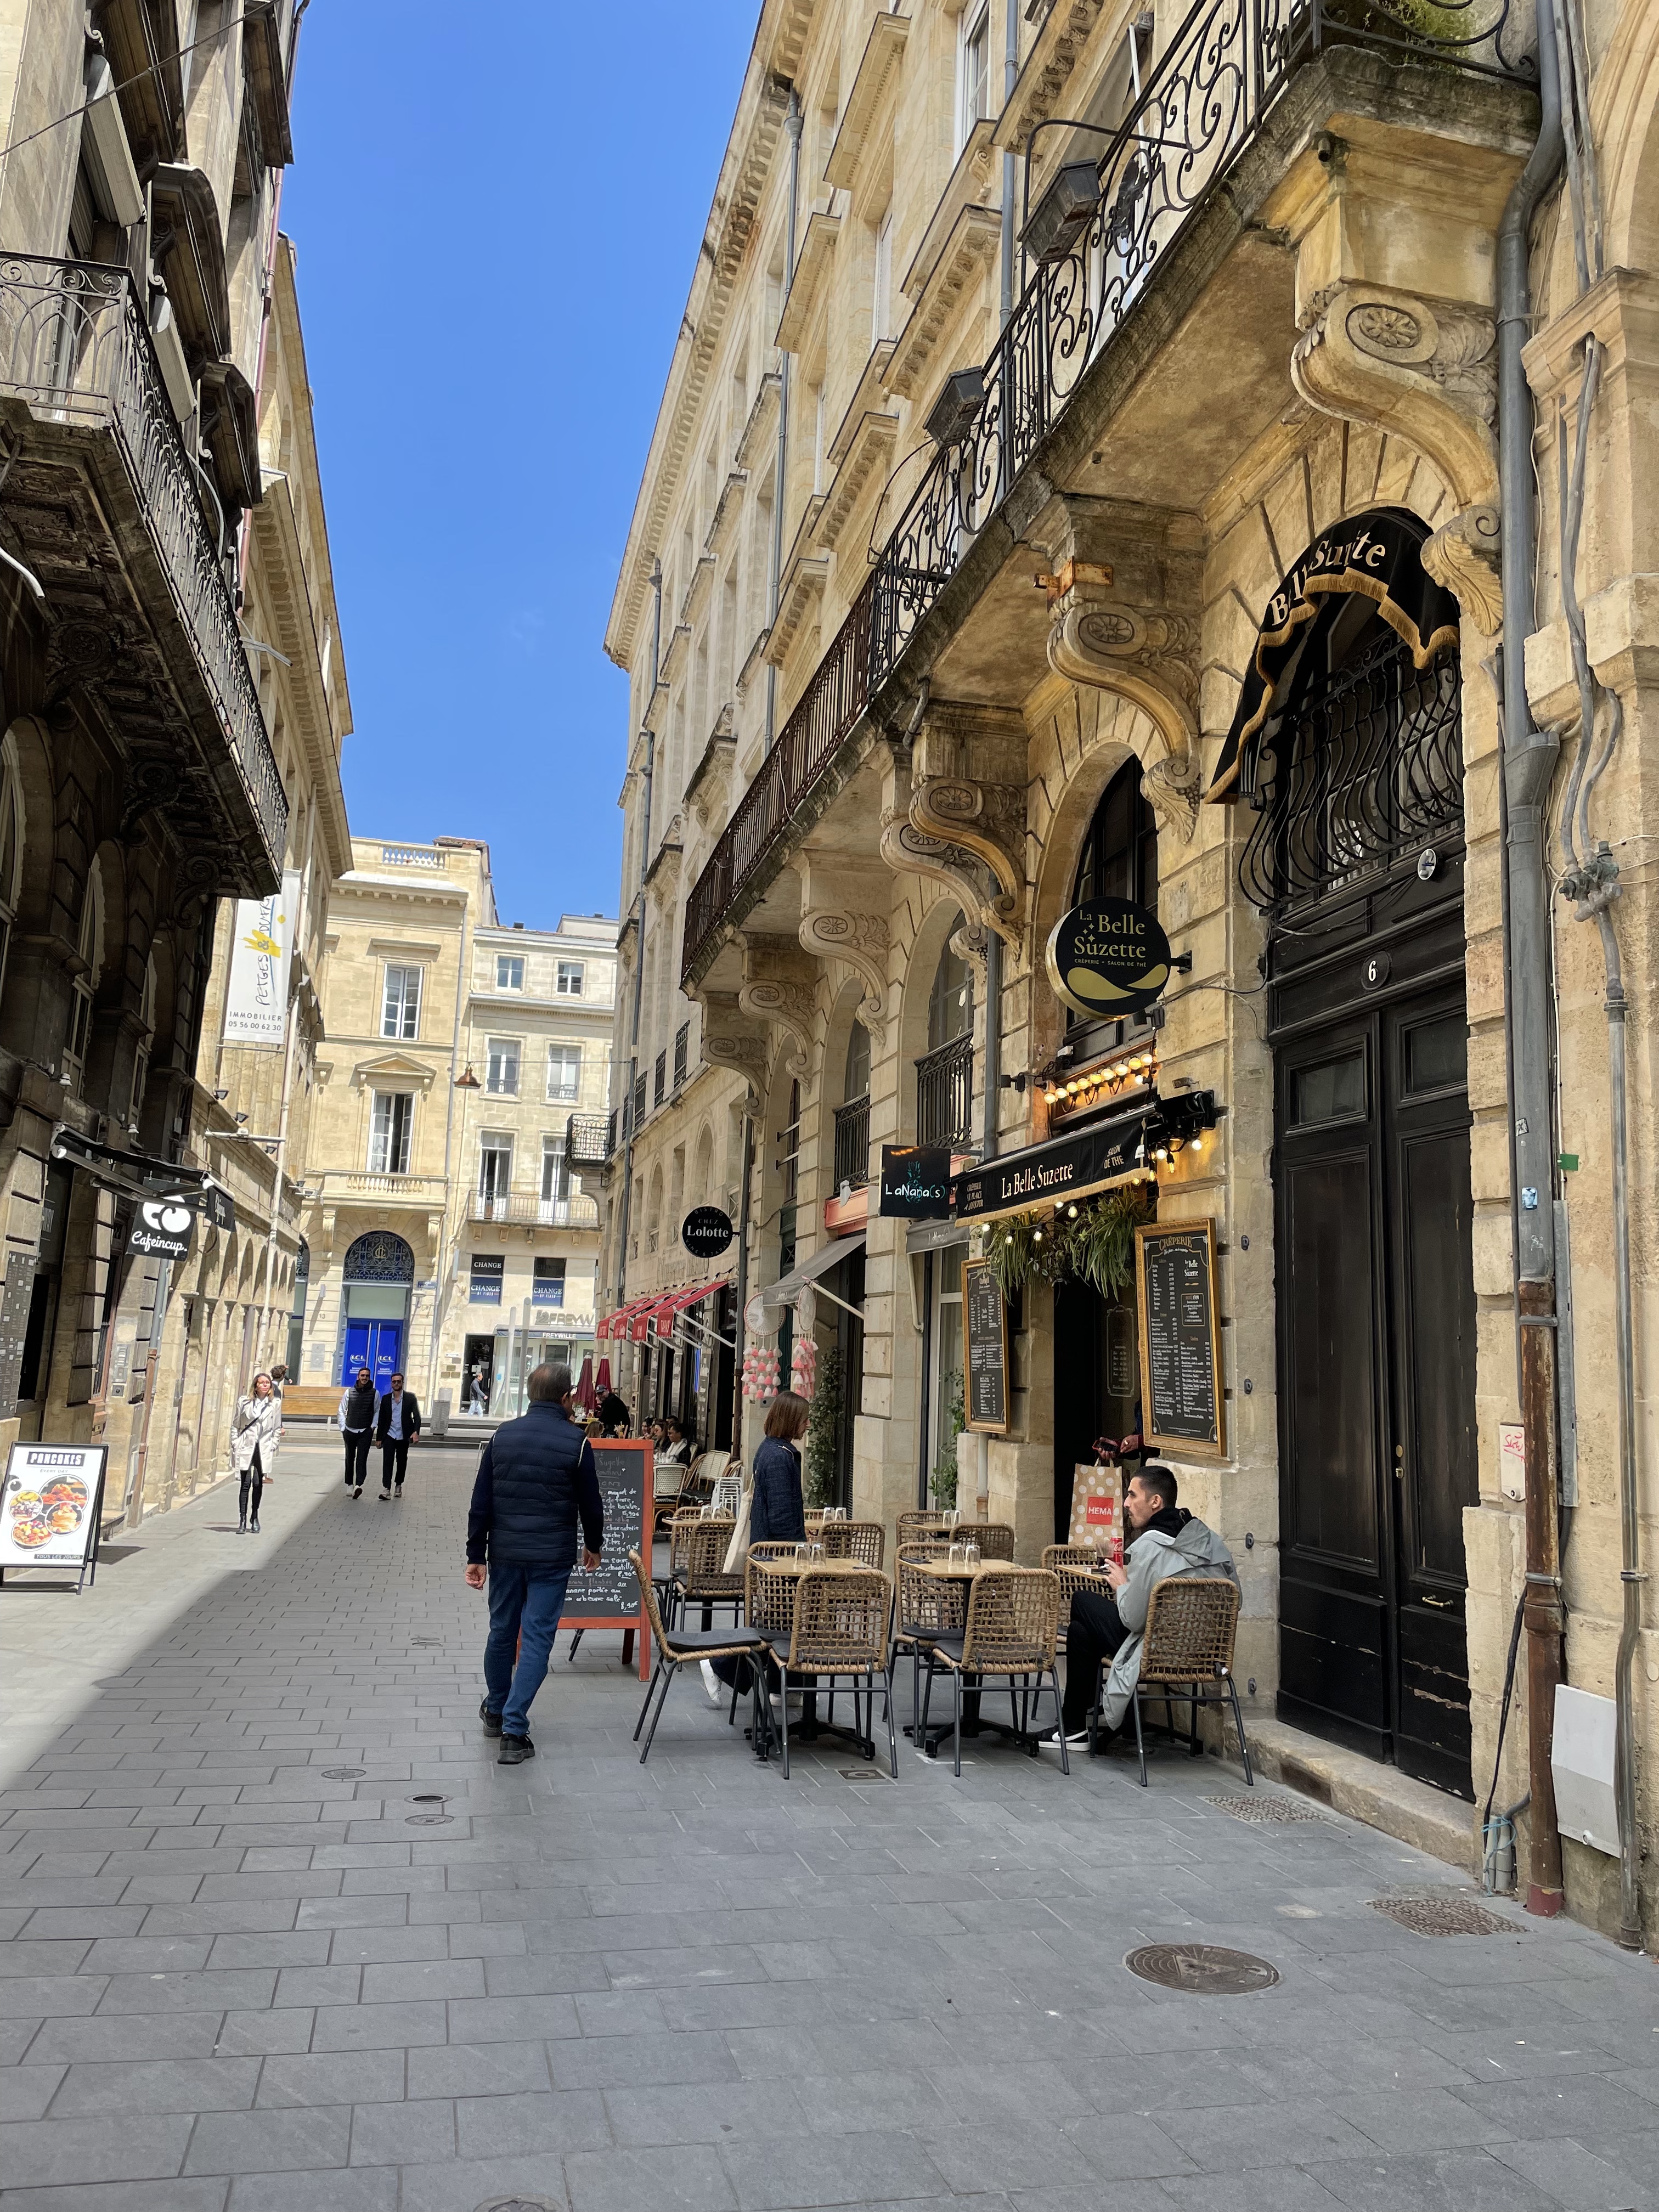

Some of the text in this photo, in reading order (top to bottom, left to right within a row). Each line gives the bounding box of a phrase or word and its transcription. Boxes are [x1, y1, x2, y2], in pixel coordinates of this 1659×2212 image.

[1079, 910, 1145, 935] La Belle
[257, 940, 269, 950] &
[1074, 936, 1146, 958] Suzette
[1368, 960, 1376, 981] 6
[229, 1011, 283, 1022] IMMOBILIER
[1001, 1162, 1073, 1199] La Belle Suzette
[694, 1207, 723, 1216] BISTRO
[687, 1225, 729, 1238] Lolotte
[1159, 1235, 1193, 1251] CRÊPERIE
[1088, 1506, 1112, 1515] HEMA
